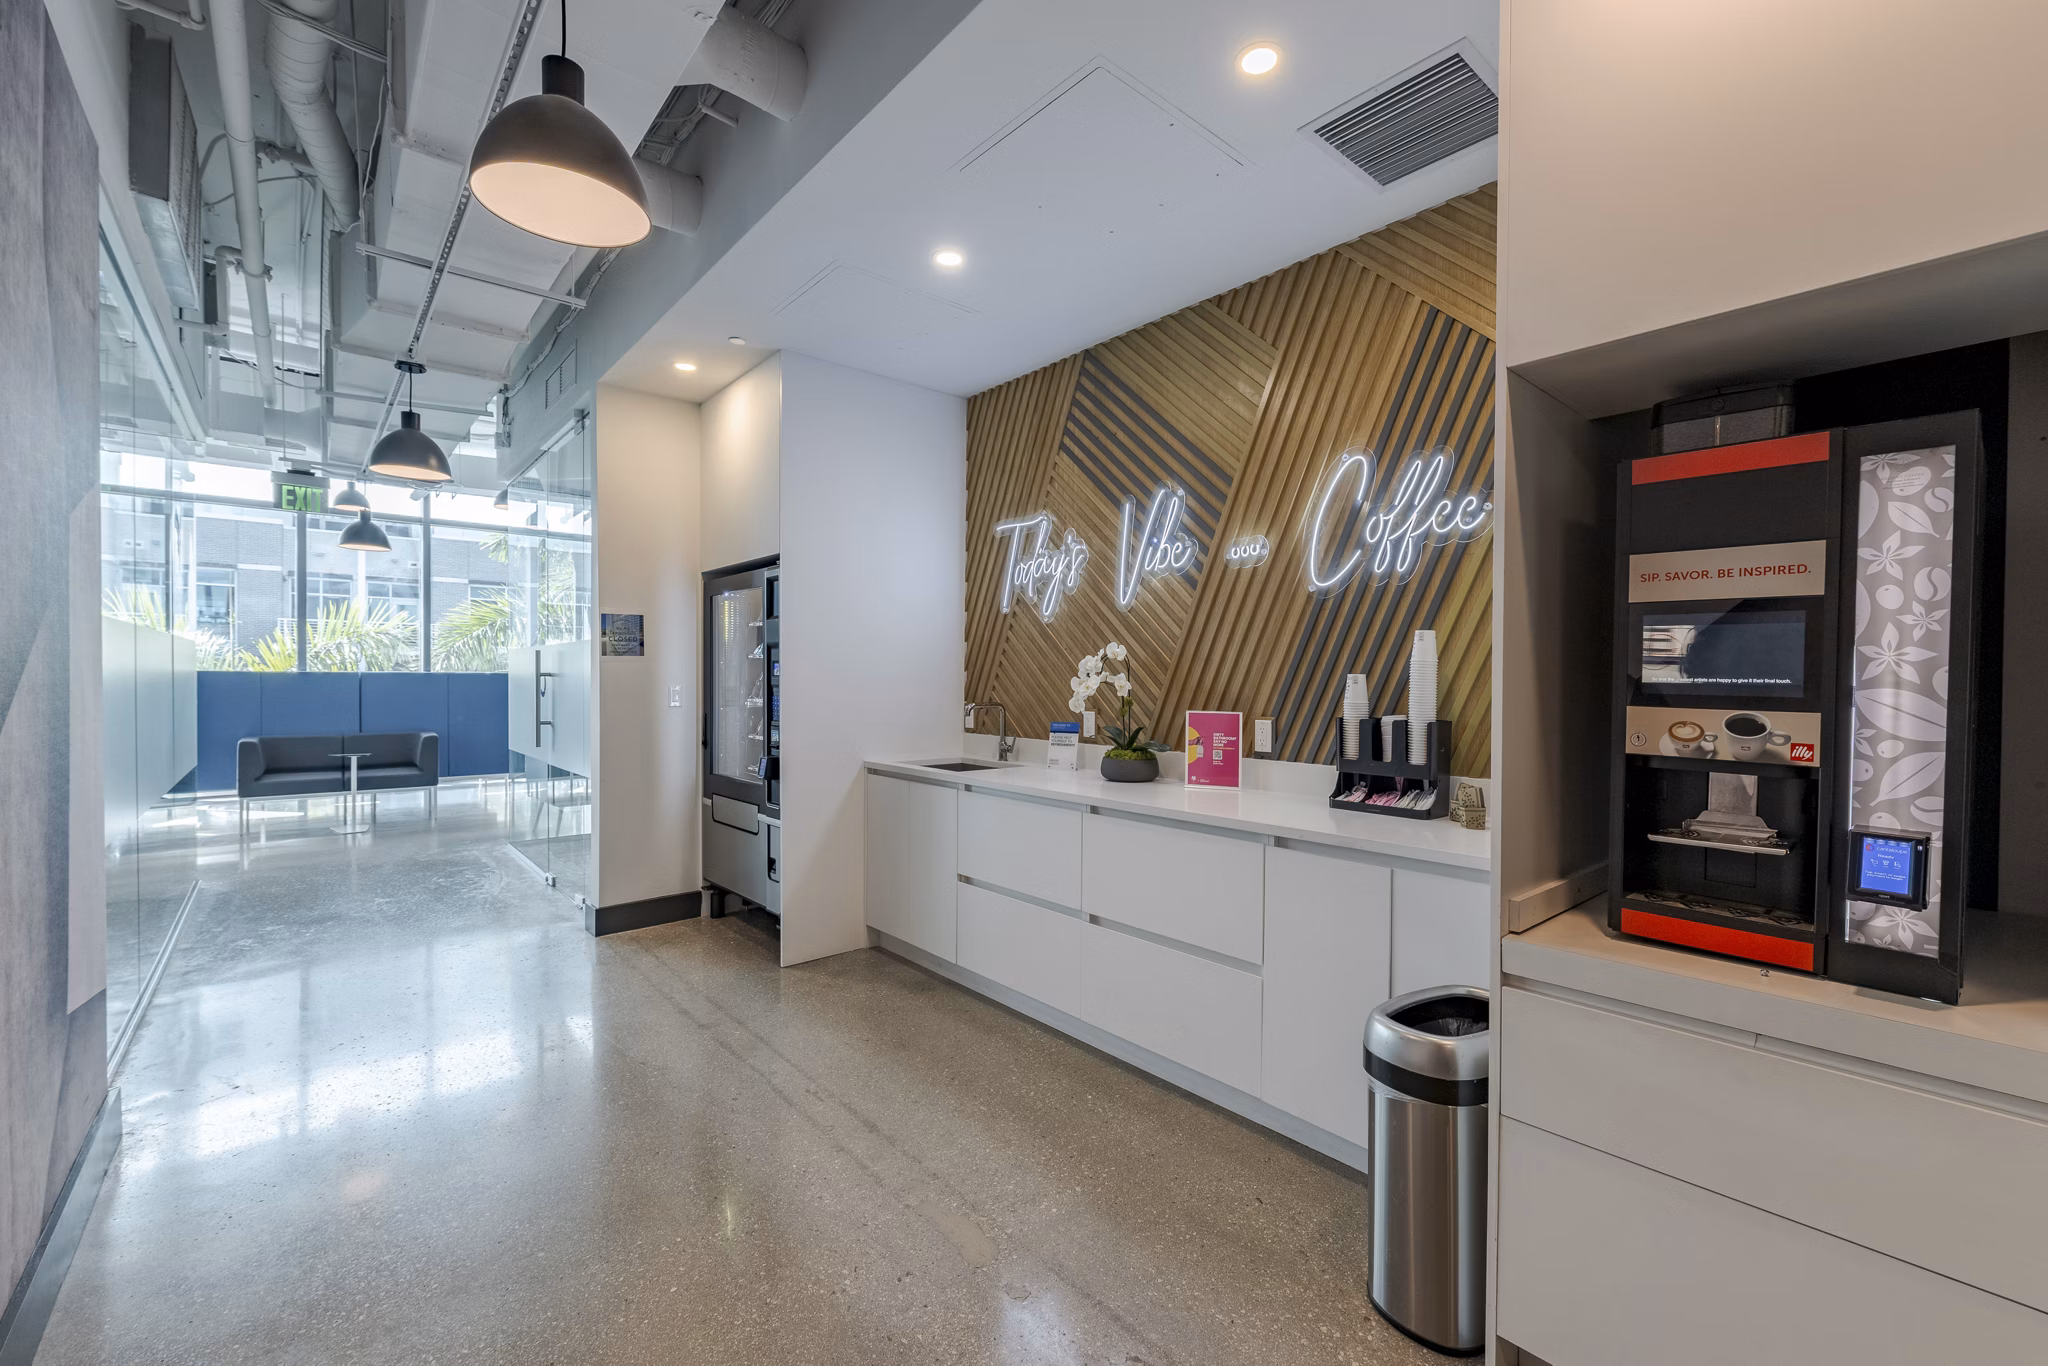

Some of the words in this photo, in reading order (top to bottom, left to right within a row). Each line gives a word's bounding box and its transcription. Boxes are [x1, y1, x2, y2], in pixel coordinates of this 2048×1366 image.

[282, 485, 324, 512] EXIT
[996, 513, 1088, 616] Today's
[1120, 487, 1192, 605] Vibe
[1311, 455, 1487, 586] Coffee
[1640, 572, 1661, 583] SIP.
[1665, 570, 1713, 582] SAVOR.
[1717, 568, 1735, 579] BE
[1738, 563, 1812, 577] INSPIRED.
[1791, 746, 1812, 760] illy
